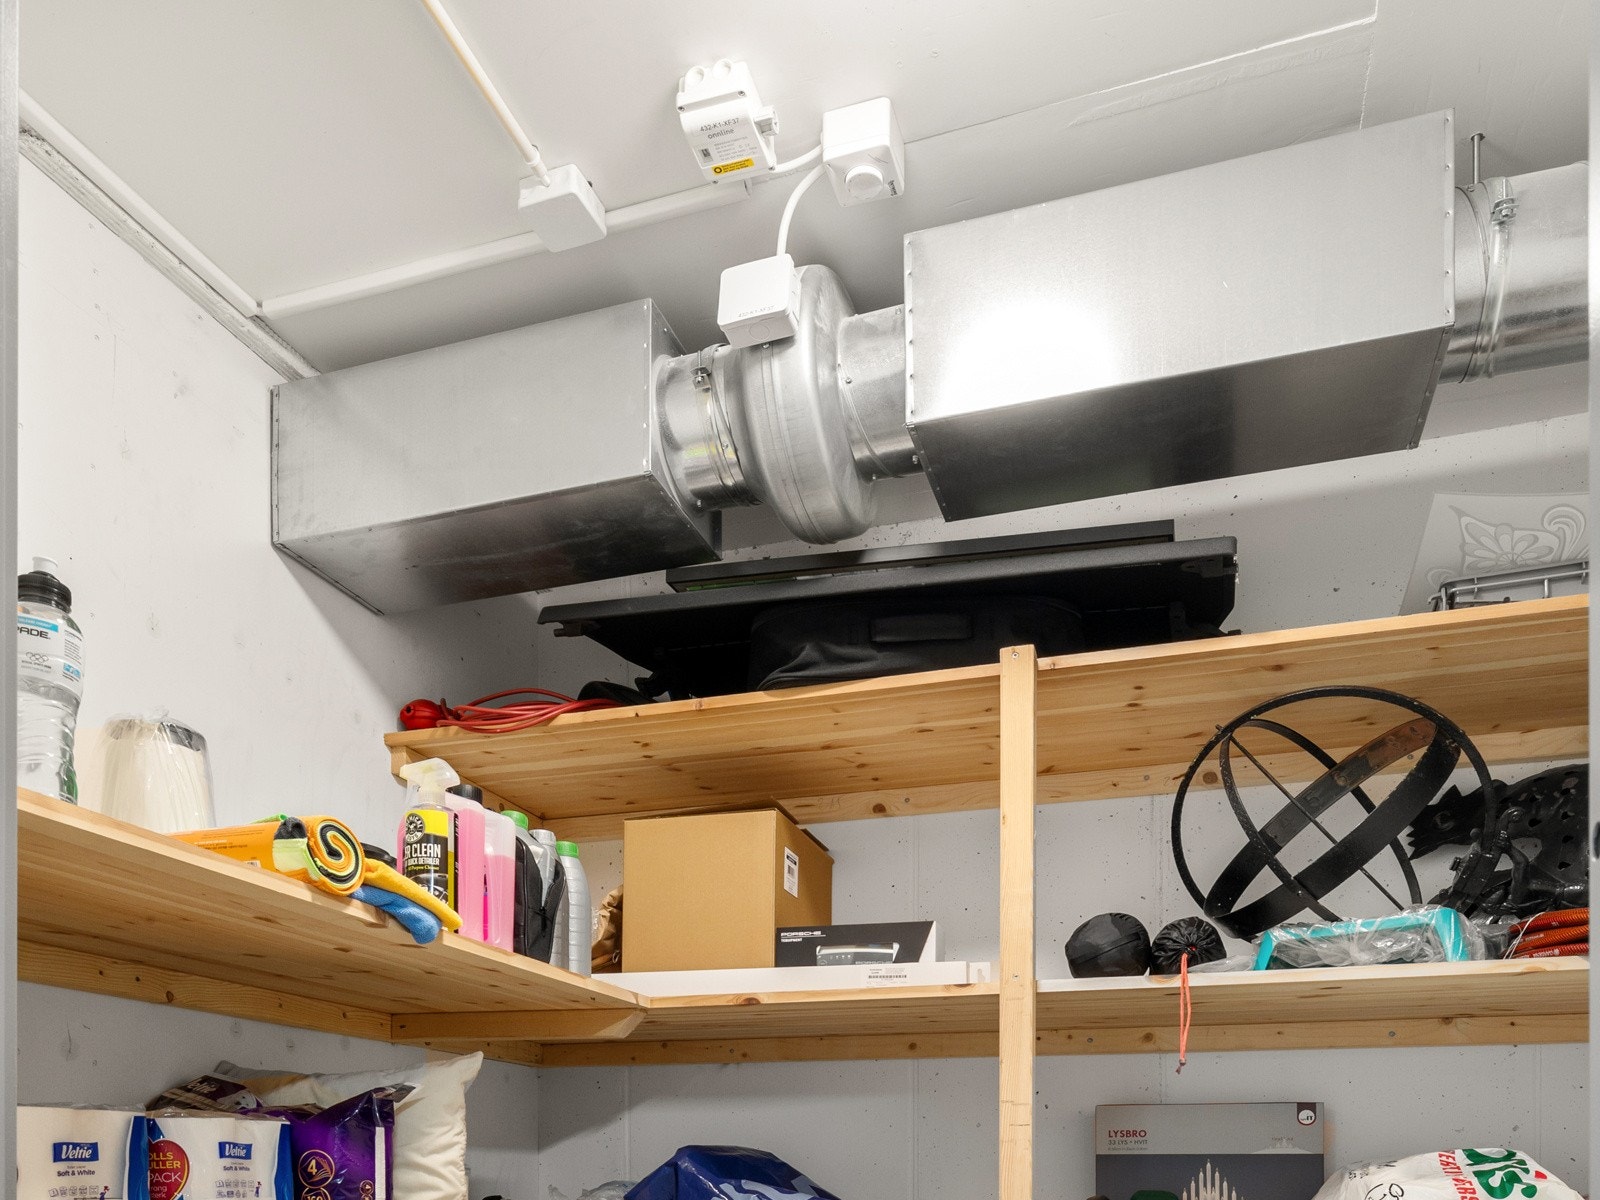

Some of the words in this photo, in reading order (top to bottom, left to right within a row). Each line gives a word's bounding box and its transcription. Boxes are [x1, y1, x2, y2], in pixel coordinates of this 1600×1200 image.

[411, 843, 441, 858] CLEAN
[1108, 1129, 1147, 1138] LYSBRO
[62, 1145, 92, 1160] Veltie
[225, 1143, 247, 1157] Veltie
[307, 1159, 317, 1175] 4
[150, 1185, 168, 1193] rong
